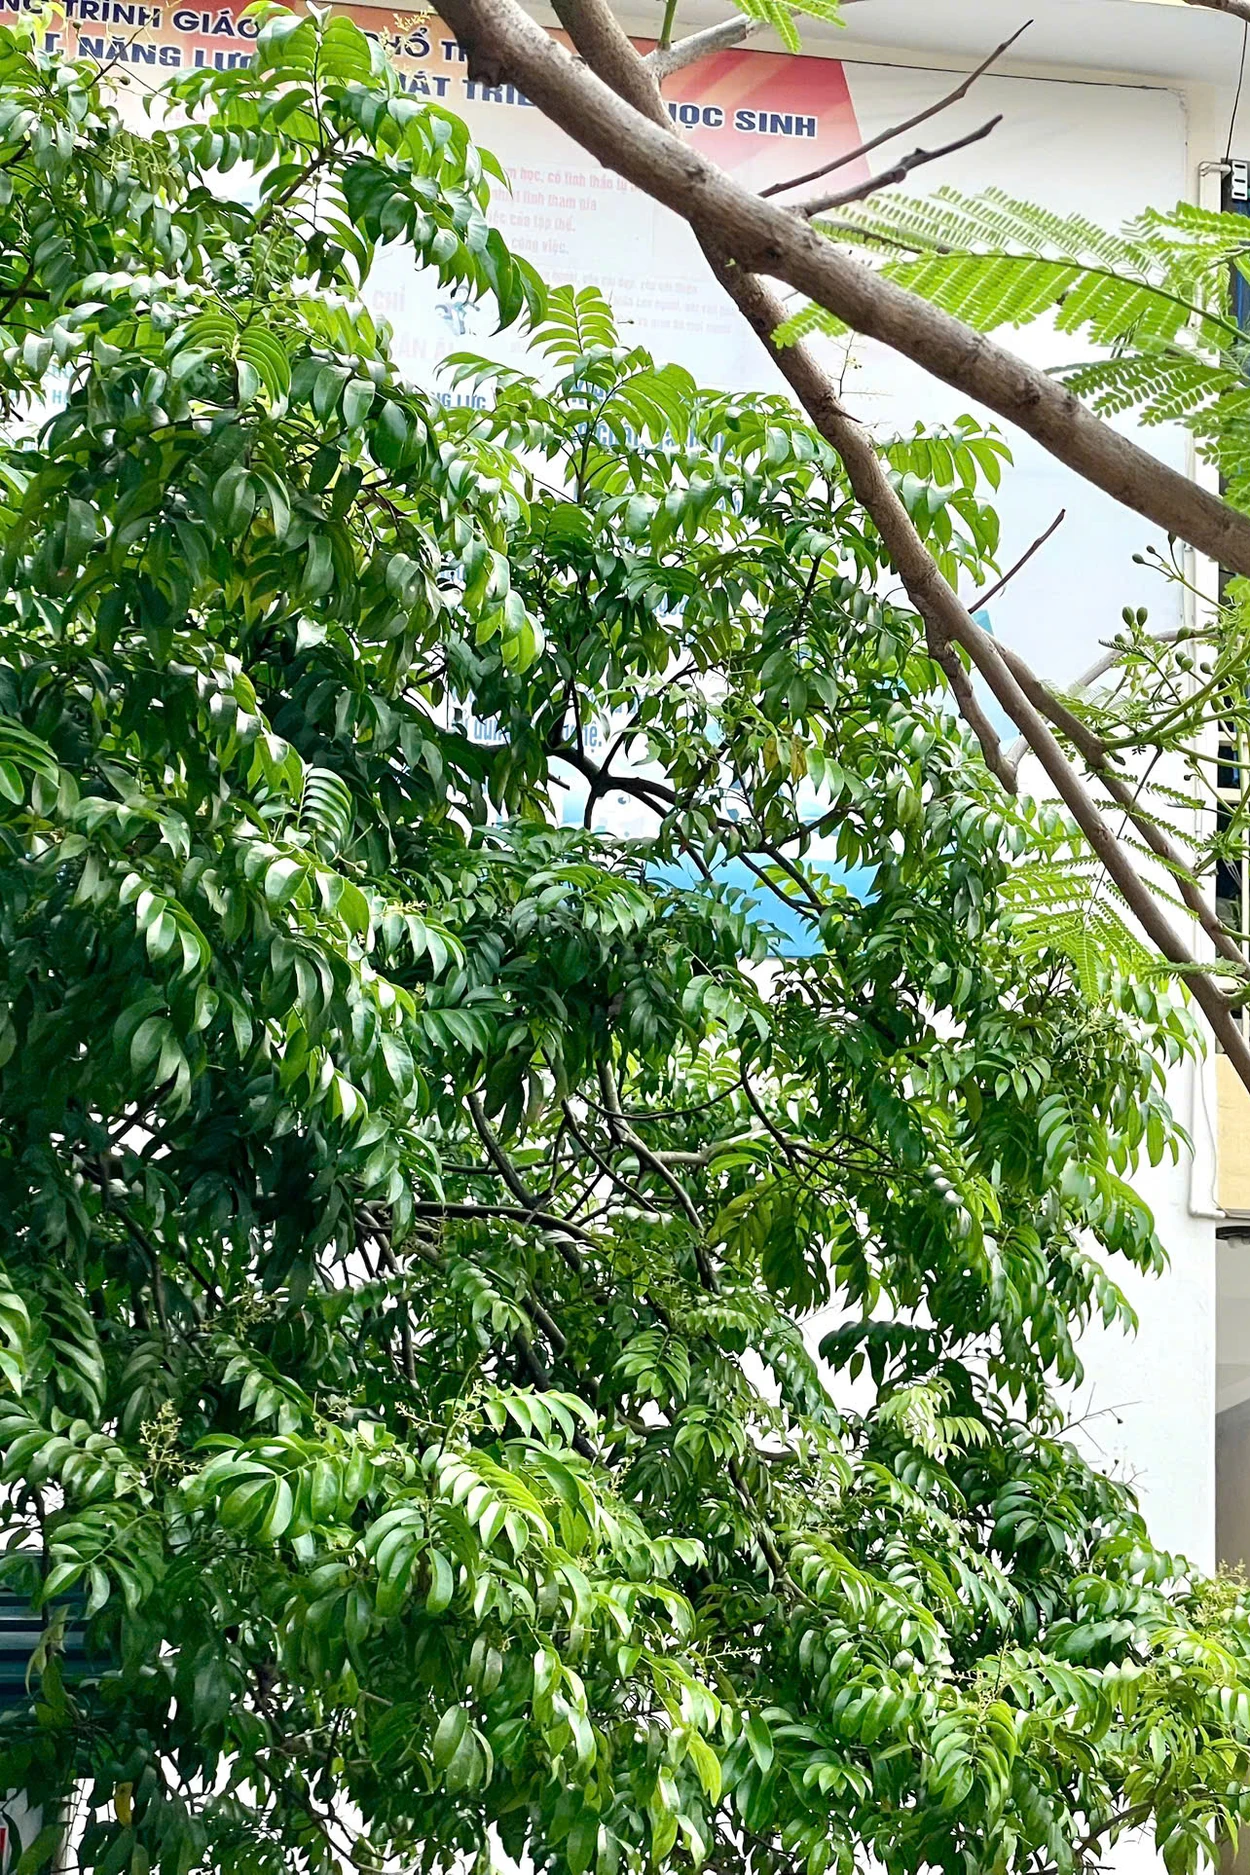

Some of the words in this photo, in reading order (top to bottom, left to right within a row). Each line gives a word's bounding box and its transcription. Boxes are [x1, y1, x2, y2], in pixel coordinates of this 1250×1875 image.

[173, 10, 260, 39] GIÁO
[79, 35, 182, 68] NĂNG
[735, 110, 815, 137] SINH
